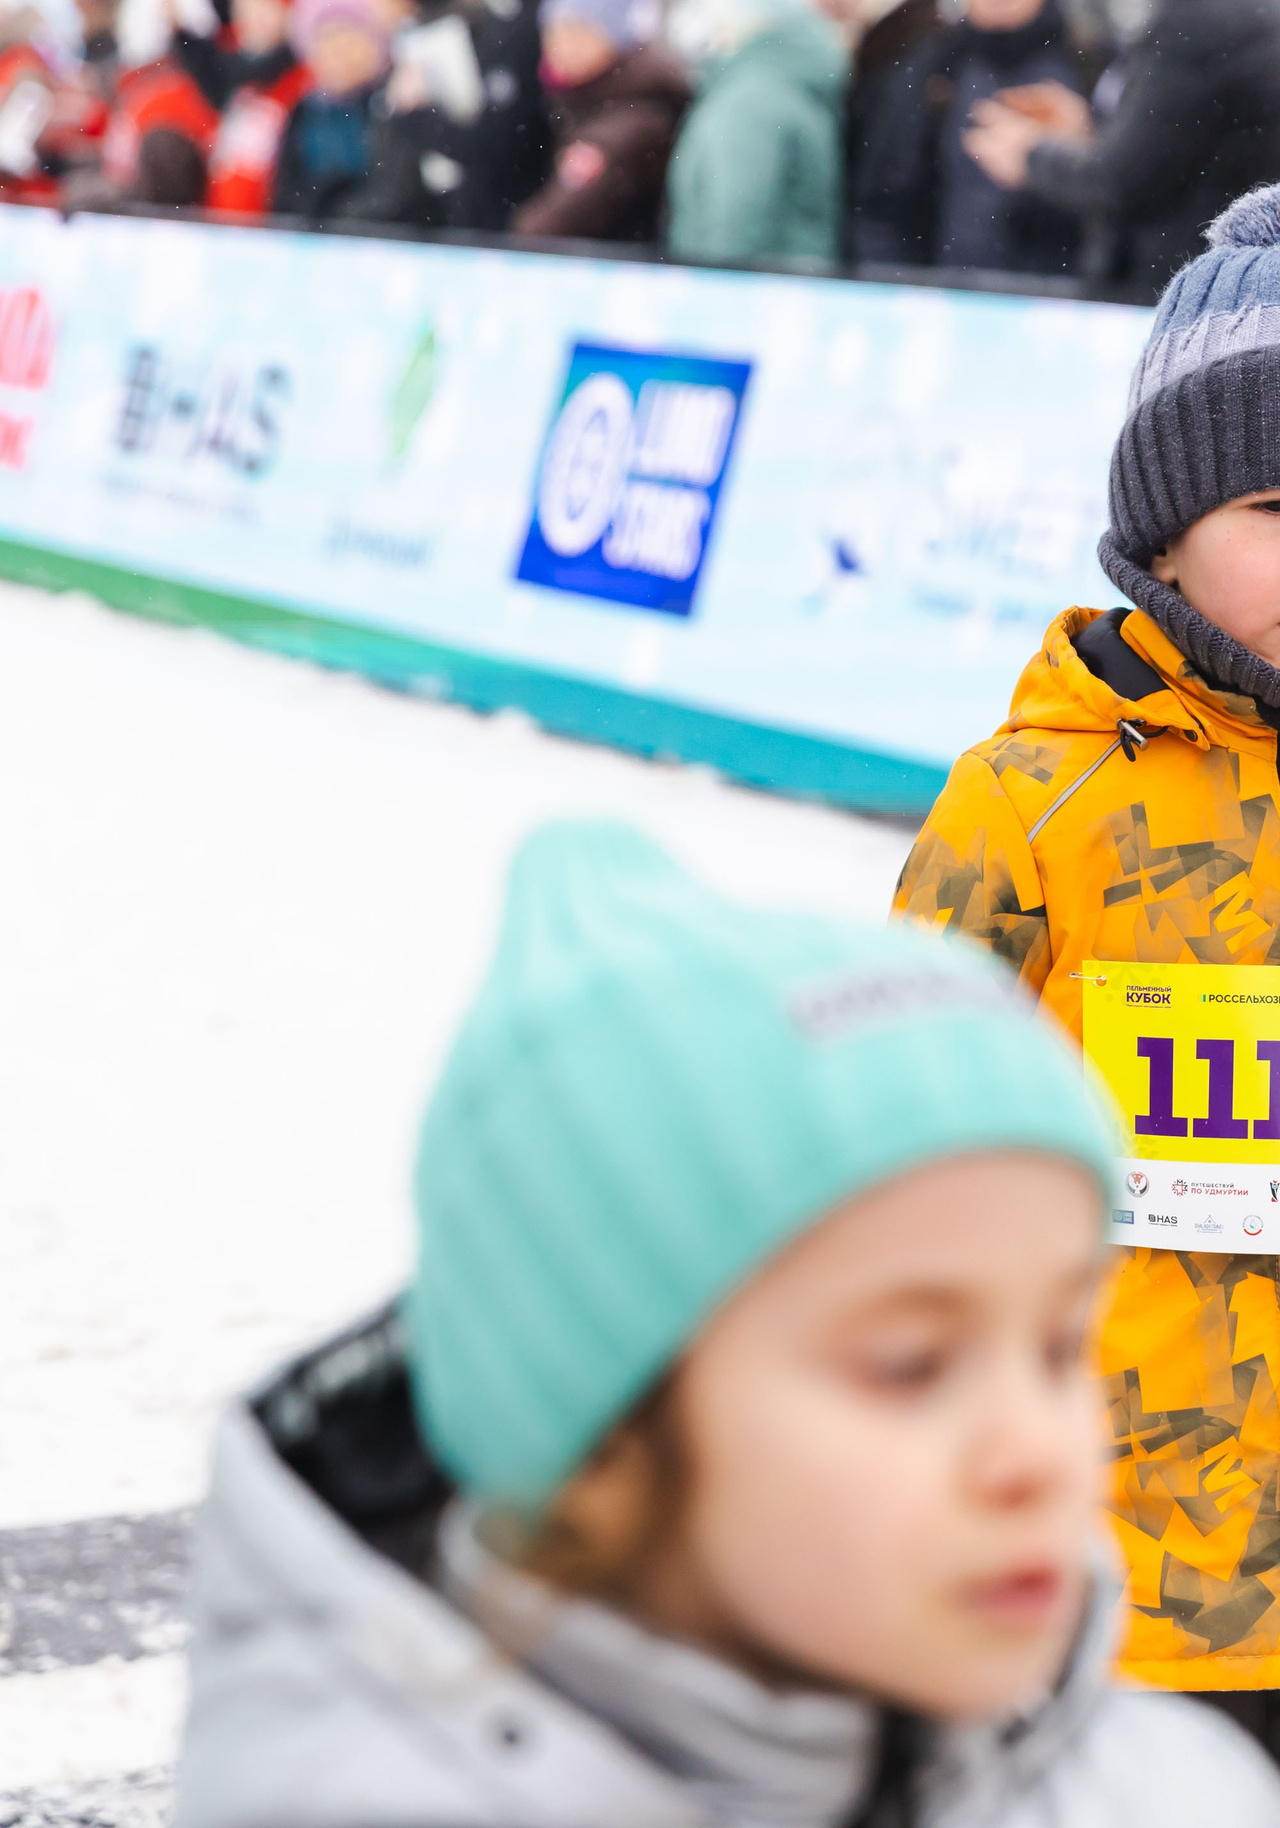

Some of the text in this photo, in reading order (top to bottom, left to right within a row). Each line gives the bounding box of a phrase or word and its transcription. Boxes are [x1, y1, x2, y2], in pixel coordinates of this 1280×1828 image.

[1126, 985, 1172, 993] ПЕЛЬМЕННЫЙ
[1126, 992, 1171, 1004] КУБОК
[1205, 1188, 1249, 1196] УДМУРТИИ
[1157, 1215, 1178, 1224] HAS
